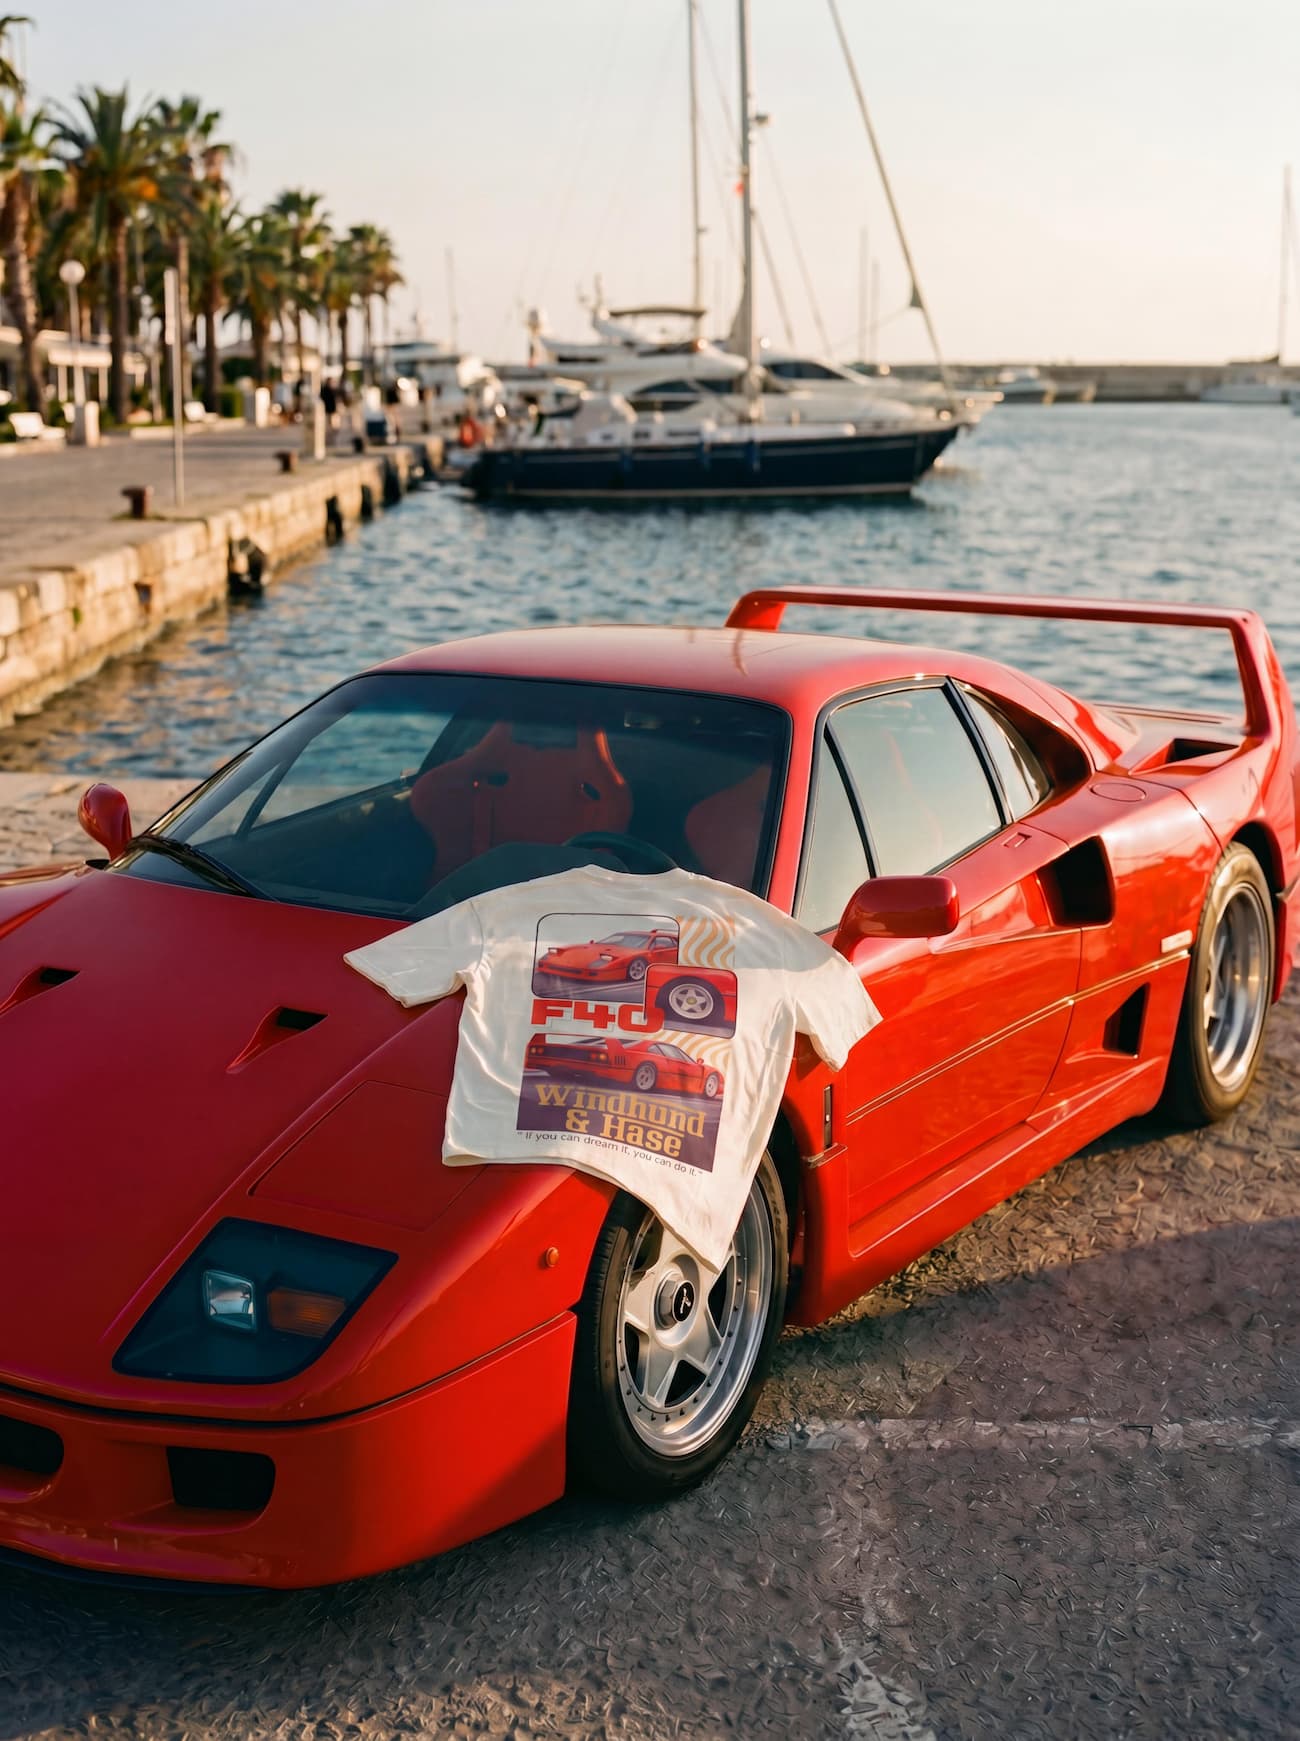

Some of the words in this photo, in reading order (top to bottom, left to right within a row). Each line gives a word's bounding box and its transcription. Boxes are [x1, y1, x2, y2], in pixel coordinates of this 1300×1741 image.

[531, 998, 665, 1034] F40
[535, 1084, 707, 1138] Windhund
[565, 1109, 589, 1134] &
[600, 1113, 684, 1158] Hase
[536, 1132, 558, 1142] you
[560, 1134, 581, 1143] can
[583, 1136, 619, 1151] dream
[633, 1149, 652, 1161] you
[654, 1156, 672, 1168] can
[674, 1162, 687, 1173] do
